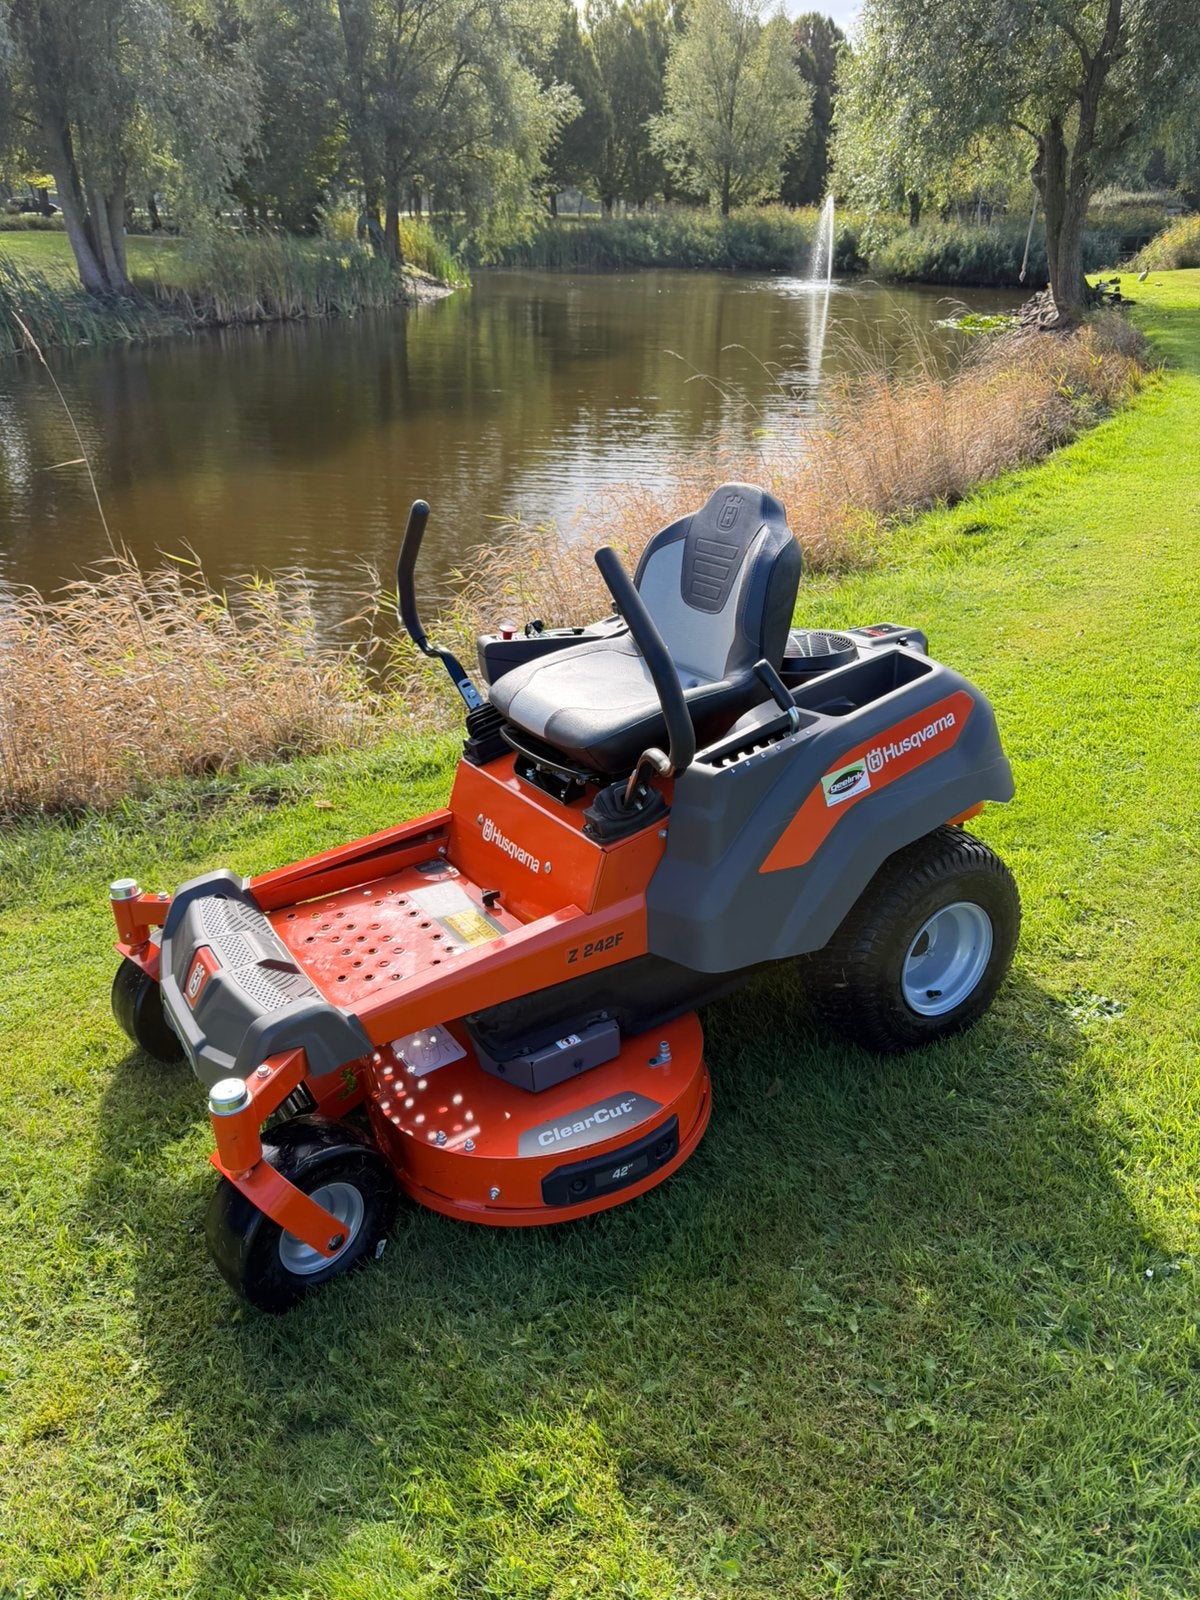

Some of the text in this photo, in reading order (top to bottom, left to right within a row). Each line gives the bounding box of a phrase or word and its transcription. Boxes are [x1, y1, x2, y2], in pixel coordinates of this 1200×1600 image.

[882, 712, 955, 763] Husqvarna
[491, 825, 540, 873] Husqvarna
[568, 931, 625, 964] Z 242F
